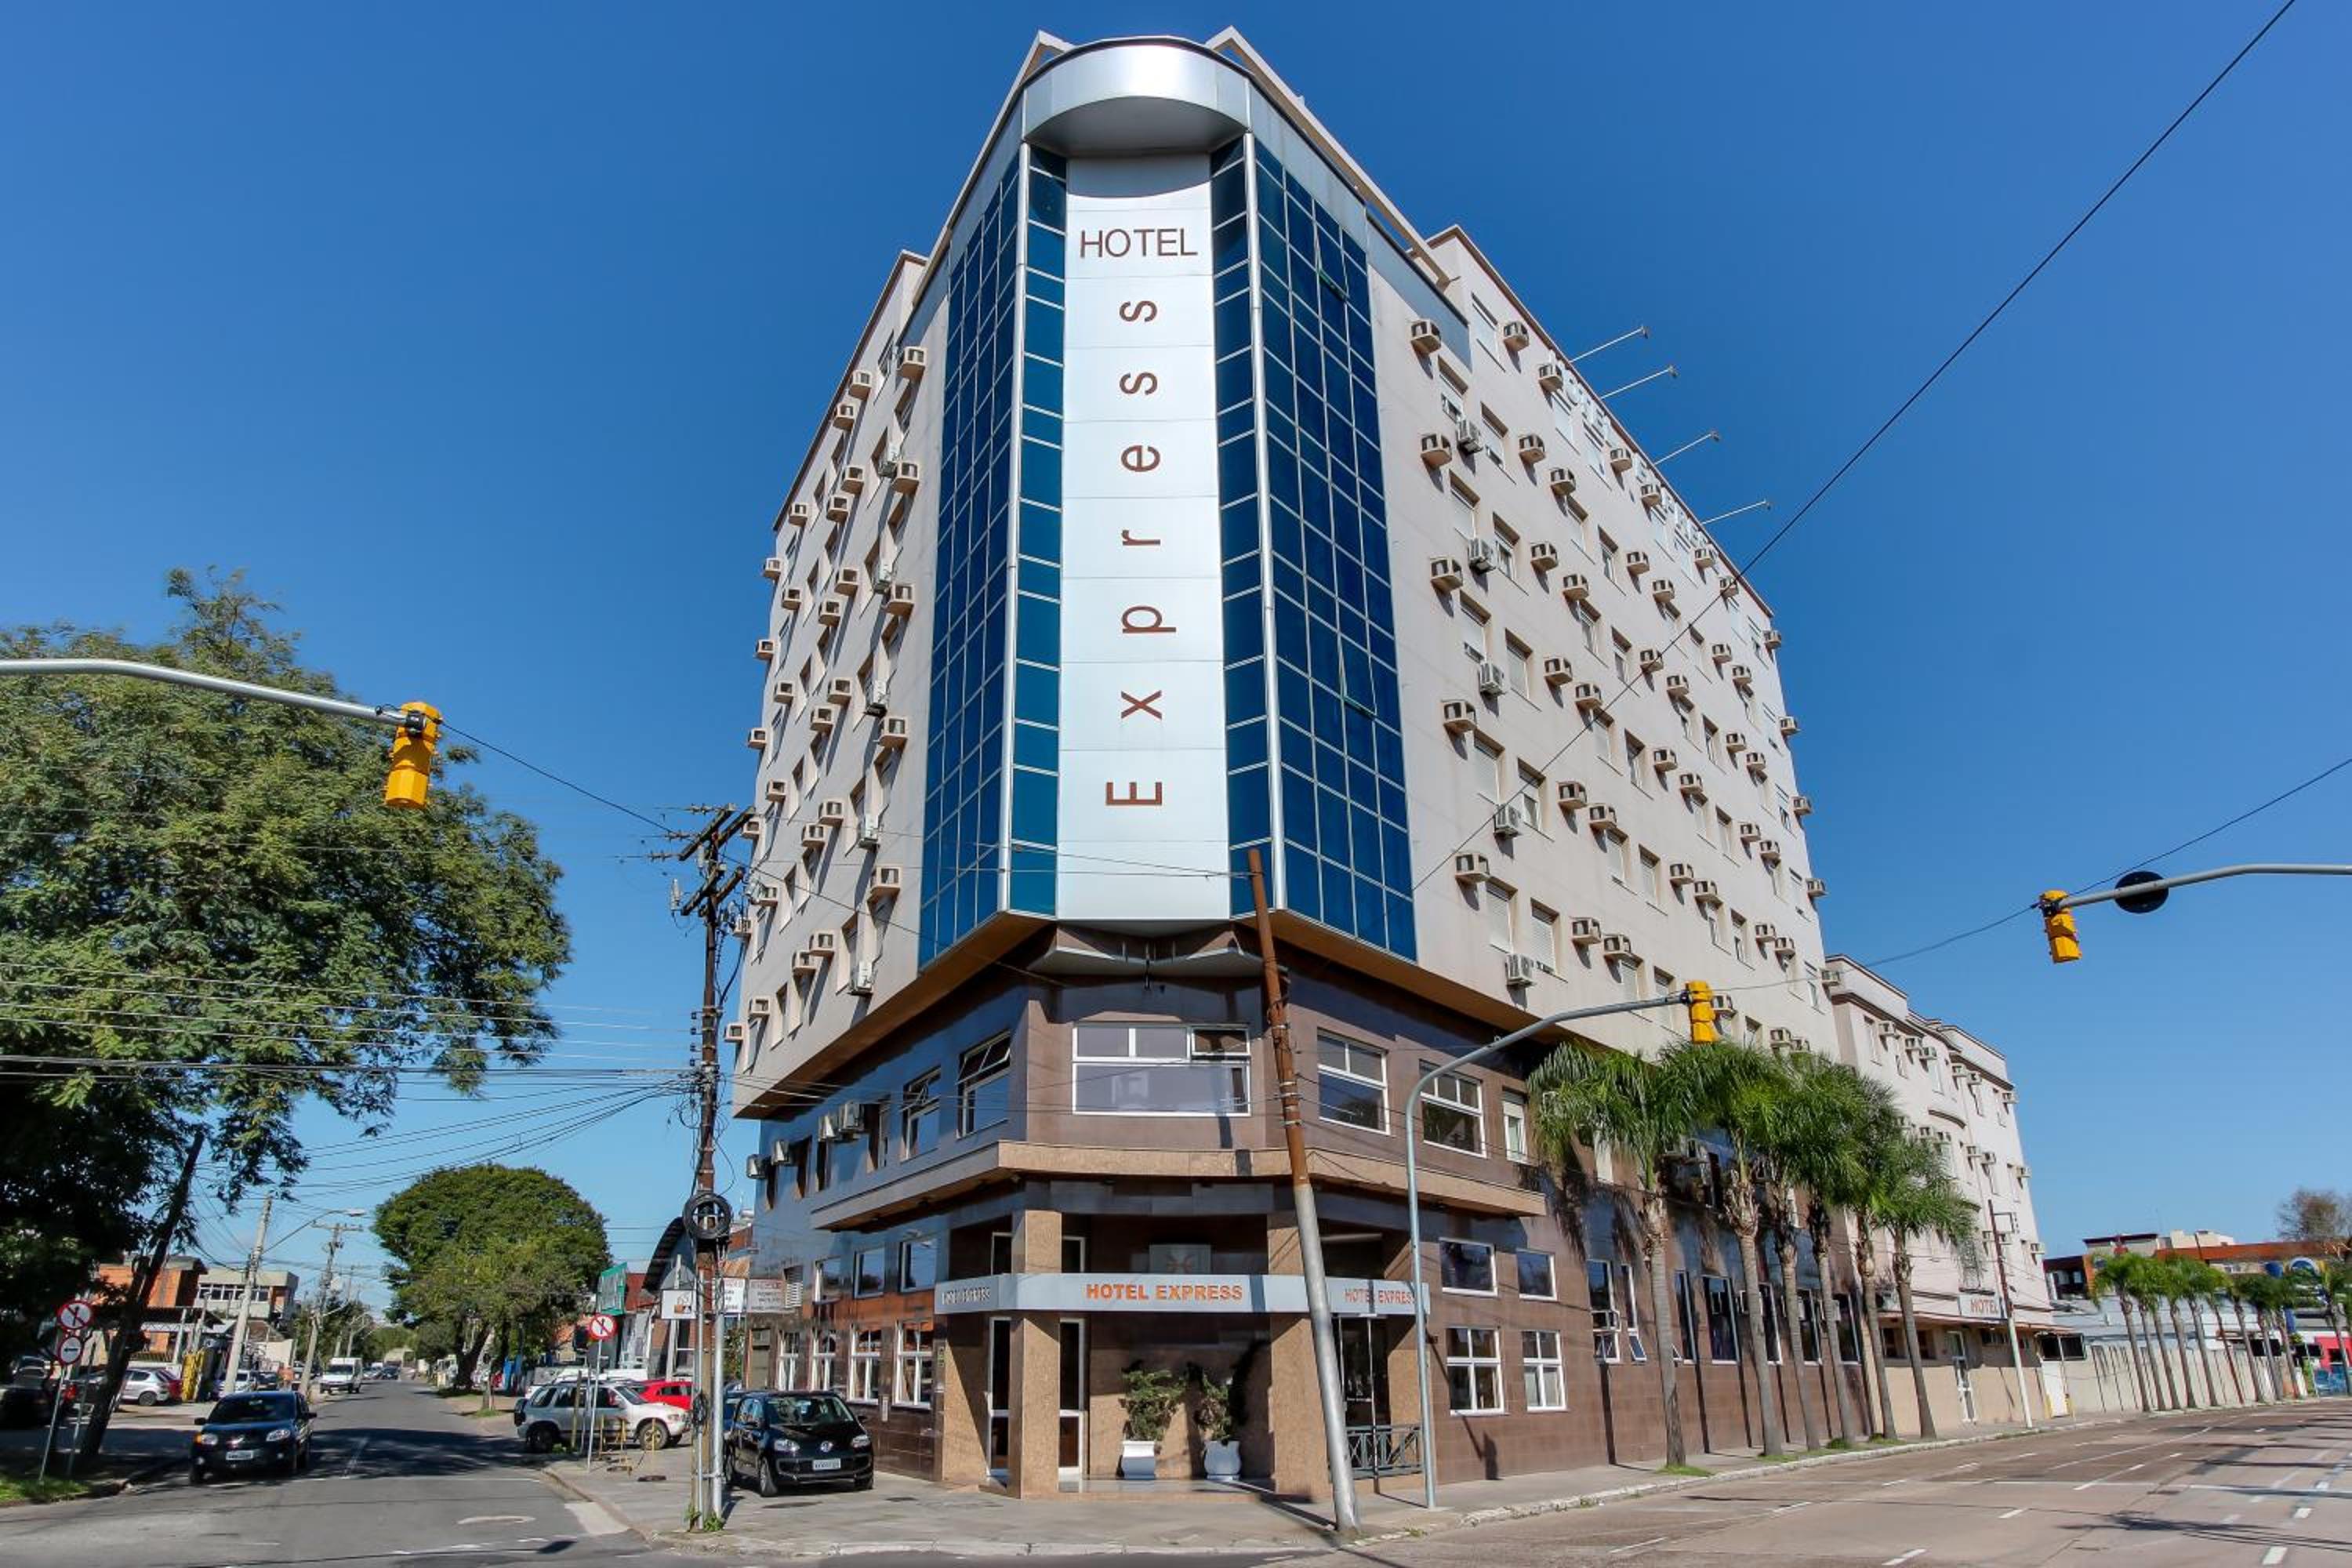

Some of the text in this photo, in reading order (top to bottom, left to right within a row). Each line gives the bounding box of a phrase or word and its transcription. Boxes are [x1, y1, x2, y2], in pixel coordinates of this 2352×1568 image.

[1080, 228, 1198, 258] HOTEL
[1105, 299, 1177, 807] Express
[1086, 1283, 1243, 1301] HOTEL EXPRESS
[1345, 1288, 1374, 1303] HOTE
